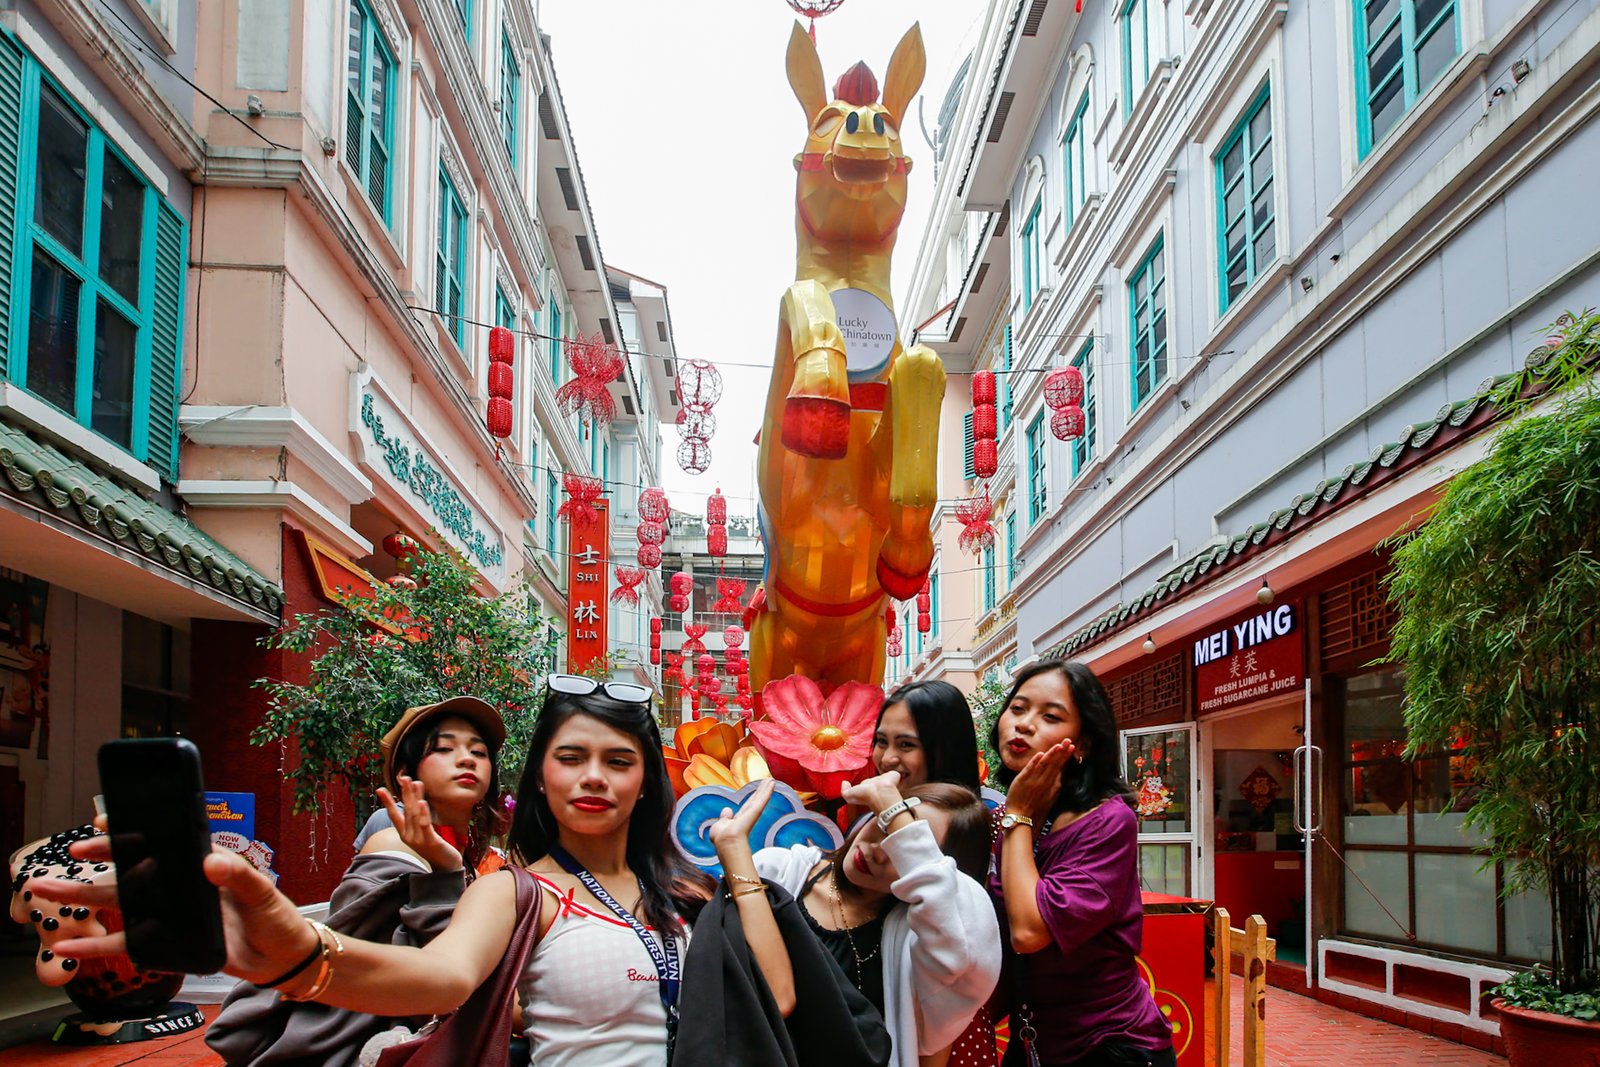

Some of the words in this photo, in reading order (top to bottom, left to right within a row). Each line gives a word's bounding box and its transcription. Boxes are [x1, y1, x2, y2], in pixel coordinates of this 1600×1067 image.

[839, 317, 868, 331] Lucky
[575, 544, 600, 565] 士
[576, 572, 599, 582] SHI
[574, 600, 600, 625] 林
[576, 629, 598, 639] LIN
[1195, 630, 1228, 666] MEI
[1233, 604, 1292, 650] YING
[1229, 650, 1258, 679] 美英
[1200, 699, 1222, 711] FRESH
[1223, 684, 1269, 706] SUGARCANE
[1270, 676, 1296, 691] JUICE
[1214, 681, 1238, 696] FRESH
[1238, 672, 1268, 689] LUMPIA
[1269, 669, 1276, 679] &
[215, 841, 240, 850] OPEN
[218, 834, 240, 843] NOW
[577, 870, 626, 915] NATIONAL
[622, 913, 669, 980] UNIVERSITY
[664, 934, 679, 981] NATION
[145, 1015, 194, 1034] SINCE
